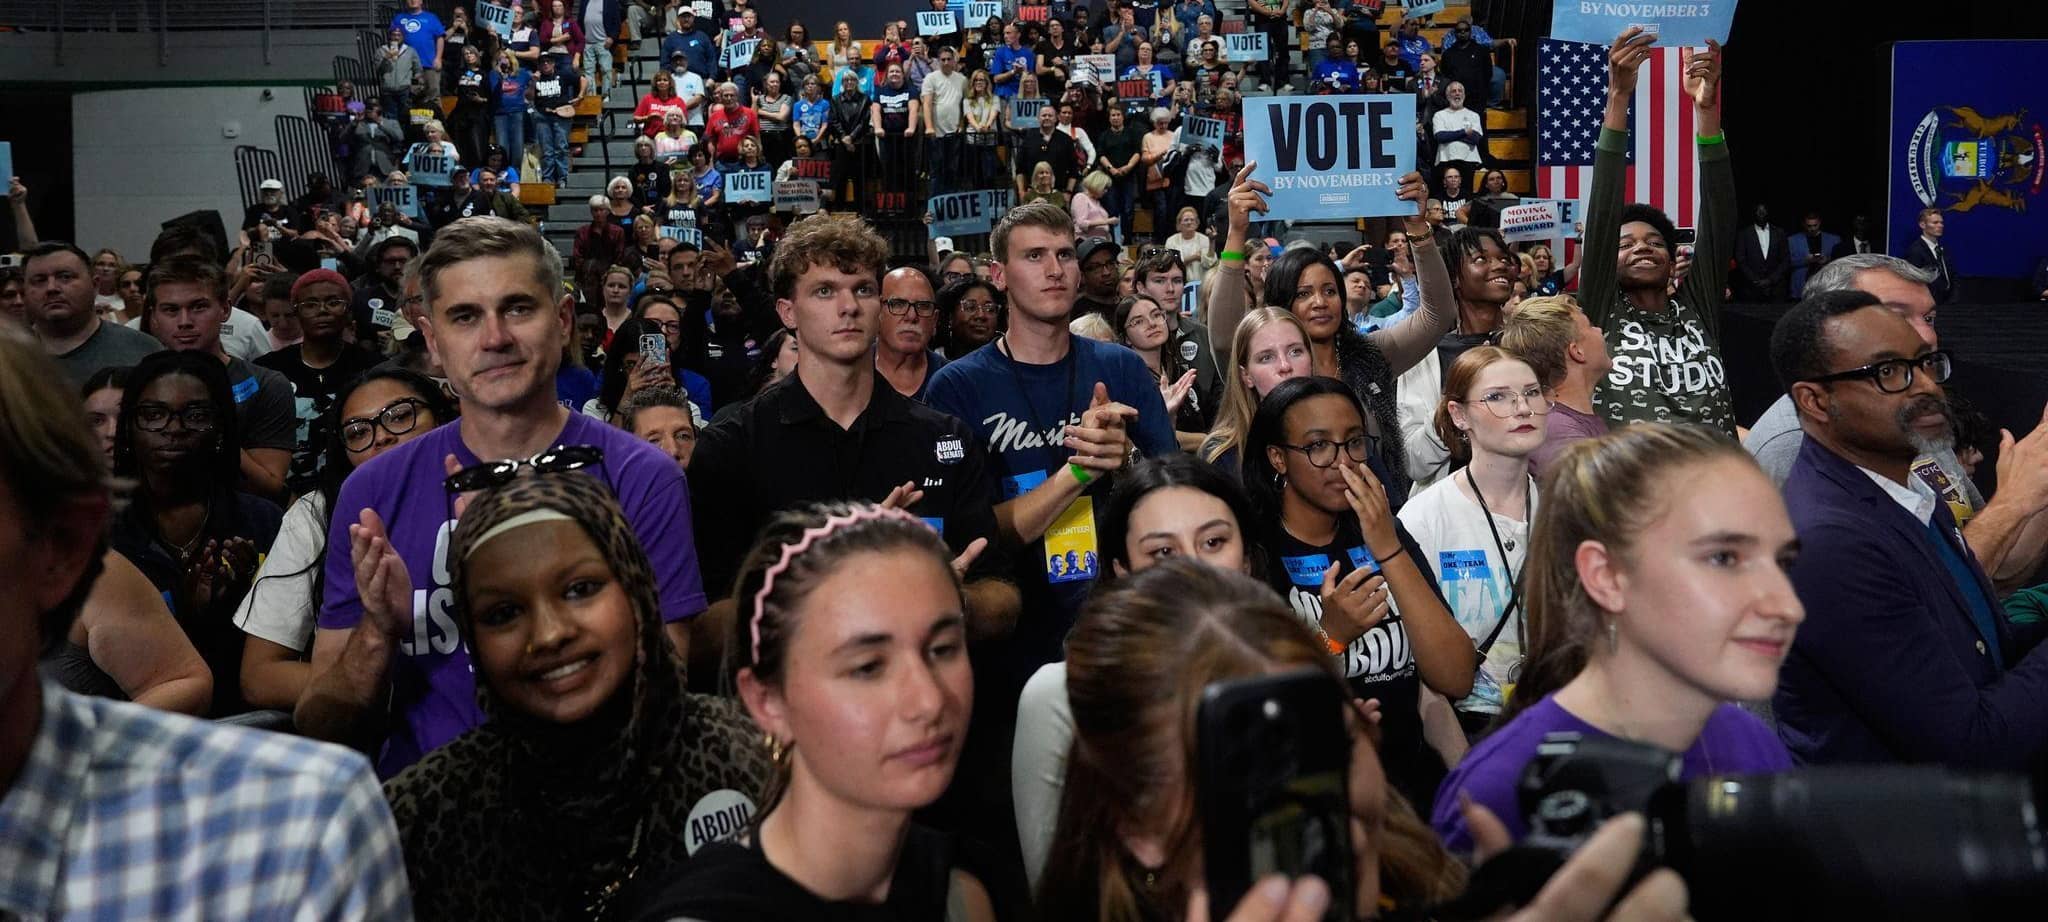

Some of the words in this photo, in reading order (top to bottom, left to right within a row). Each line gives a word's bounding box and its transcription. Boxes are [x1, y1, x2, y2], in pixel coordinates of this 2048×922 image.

[480, 5, 509, 24] VOTE
[969, 4, 997, 17] VOTE
[1019, 6, 1047, 21] VOTE
[1580, 3, 1600, 14] BY
[1604, 3, 1697, 17] NOVEMBER
[1700, 4, 1710, 16] 3
[922, 13, 950, 26] VOTE
[1232, 34, 1262, 50] VOTE
[1118, 80, 1149, 97] VOTE
[1188, 117, 1220, 139] VOTE
[1267, 101, 1396, 172] VOTE
[414, 155, 448, 173] VOTE
[798, 160, 831, 178] VOTE
[731, 174, 765, 190] VOTE
[1274, 176, 1295, 190] BY
[1297, 174, 1382, 189] NOVEMBER
[1384, 173, 1393, 186] 3
[374, 187, 410, 206] VOTE
[668, 209, 696, 220] ABDUL
[934, 194, 981, 221] VOTE
[1507, 206, 1546, 216] MOVING
[1503, 214, 1553, 225] MICHIGAN
[1504, 222, 1554, 234] FORWARD
[937, 440, 964, 453] ABDUL
[1463, 560, 1486, 568] TEAM
